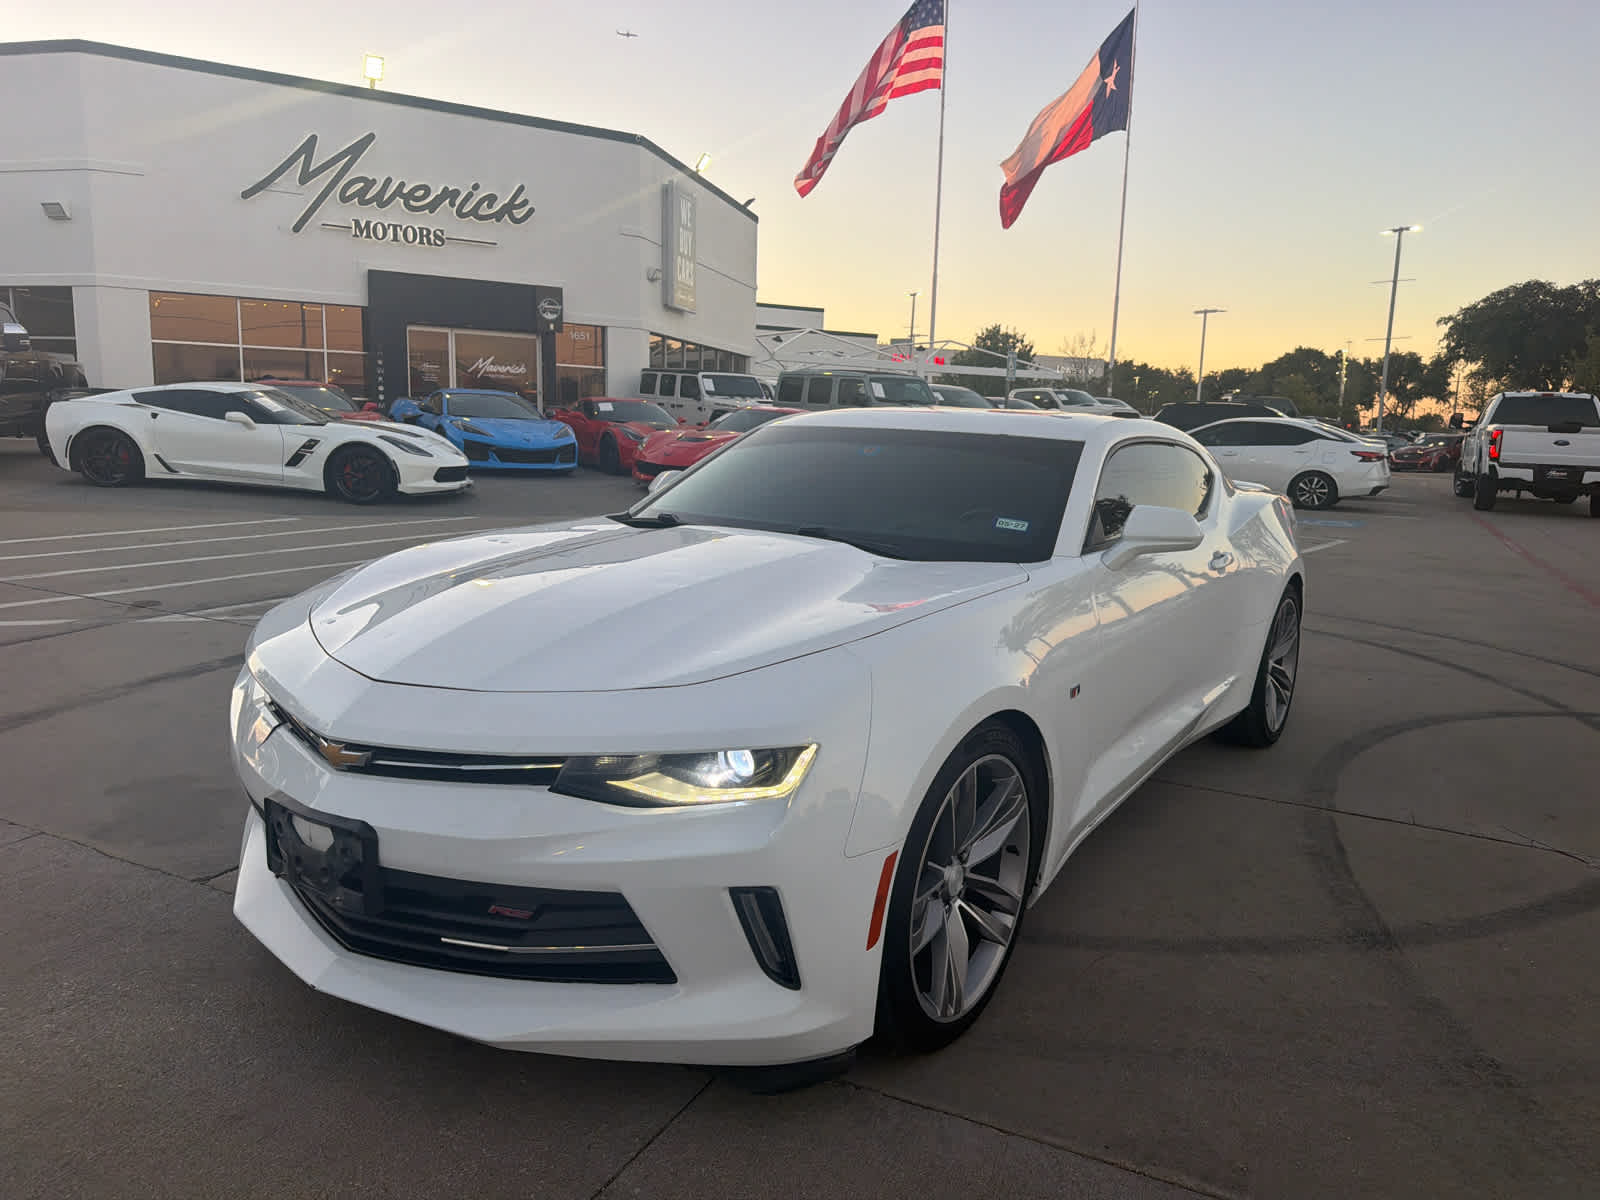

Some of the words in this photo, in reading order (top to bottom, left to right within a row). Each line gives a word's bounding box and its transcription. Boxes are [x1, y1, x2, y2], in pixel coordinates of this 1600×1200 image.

[241, 132, 535, 233] Maverick
[351, 219, 446, 247] MOTORS
[467, 355, 527, 378] Maverick
[488, 904, 536, 919] RS
